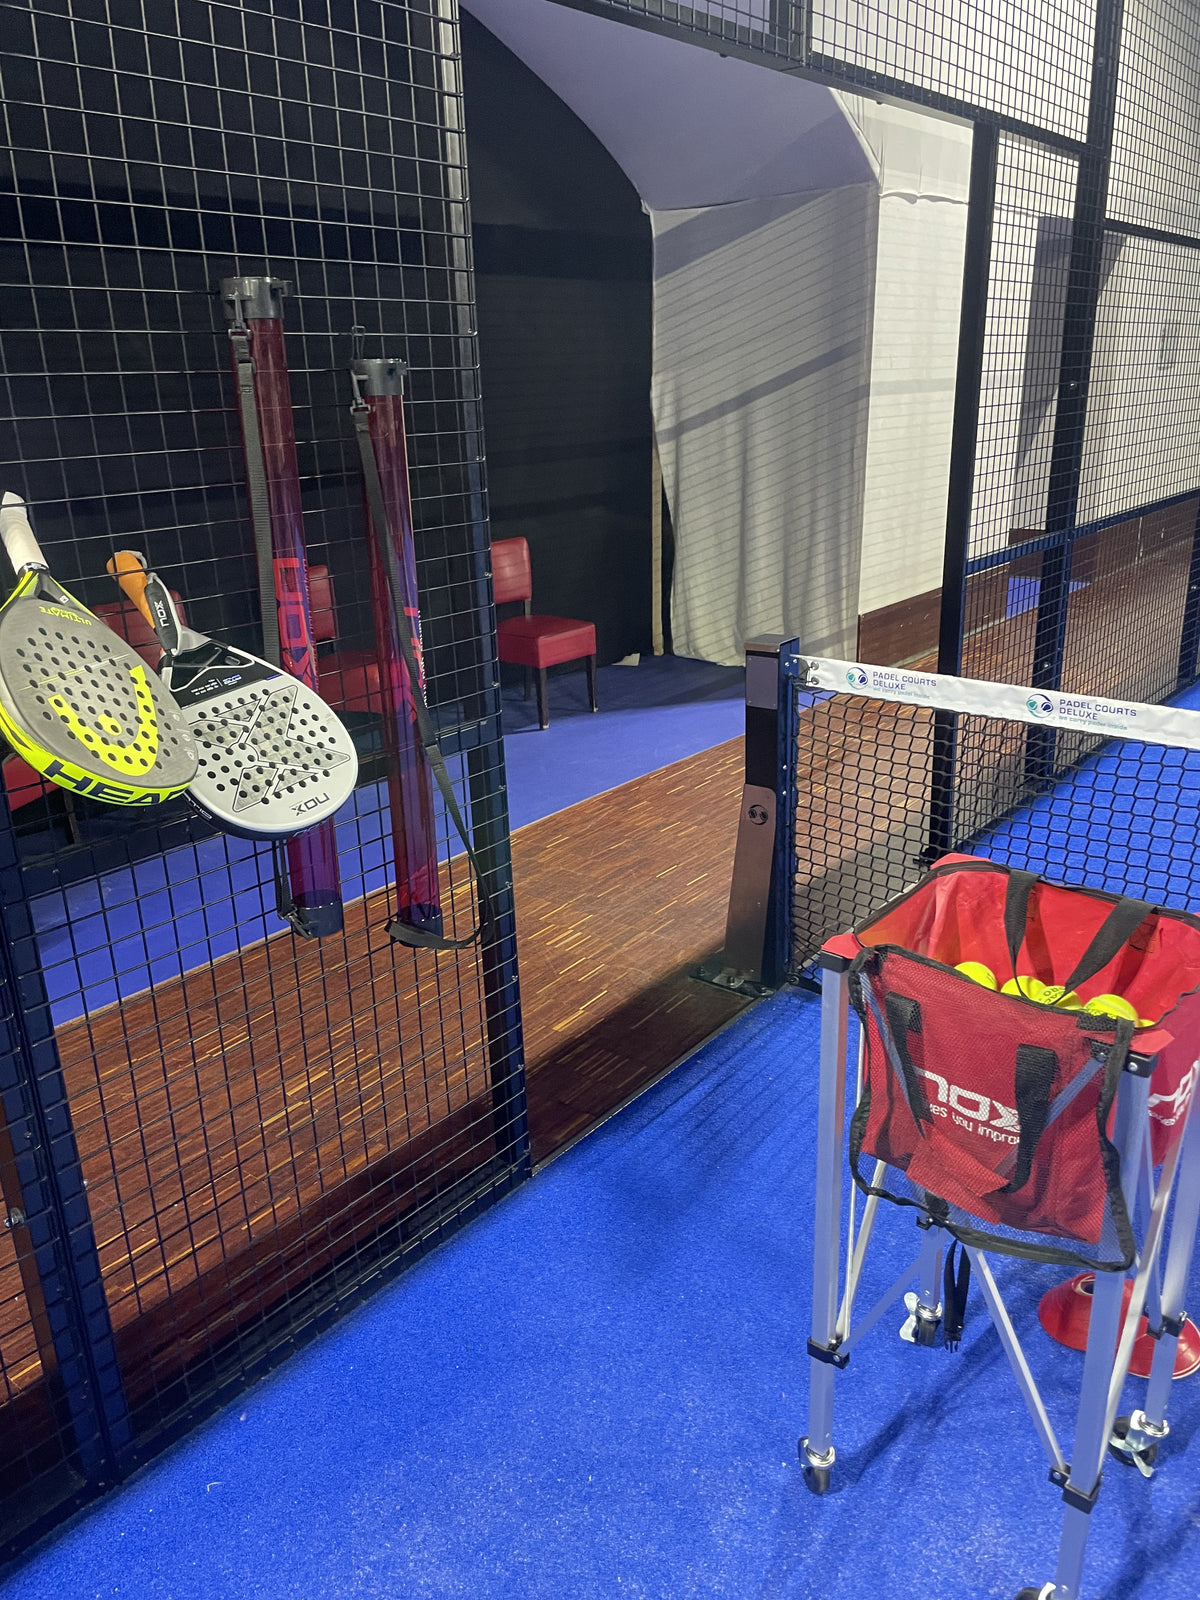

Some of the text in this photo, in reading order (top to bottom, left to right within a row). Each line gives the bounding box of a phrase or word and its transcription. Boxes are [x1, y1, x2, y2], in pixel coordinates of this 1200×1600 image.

[872, 671, 937, 687] PADEL COURTS
[872, 679, 906, 690] DELUXE
[1059, 699, 1137, 717] PADEL COURTS
[1059, 707, 1098, 720] DELUXE
[951, 1111, 974, 1132] you
